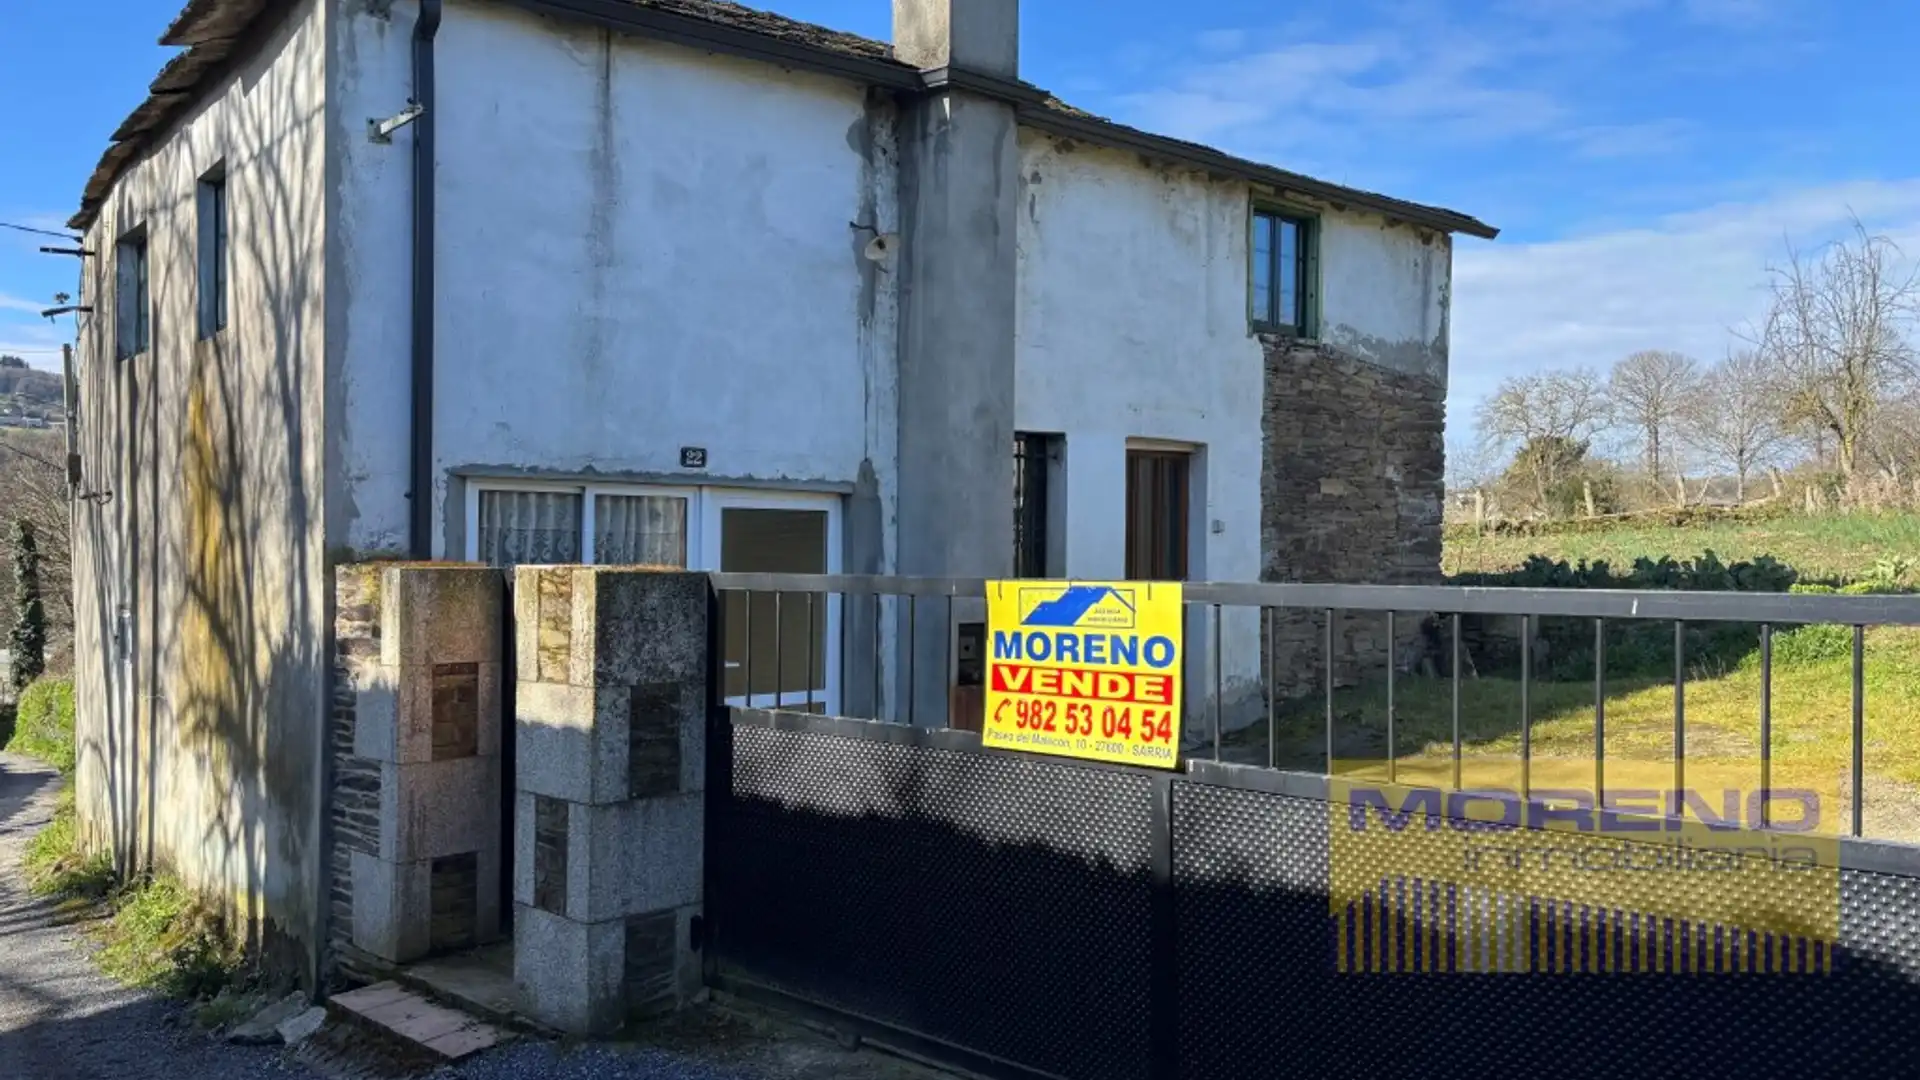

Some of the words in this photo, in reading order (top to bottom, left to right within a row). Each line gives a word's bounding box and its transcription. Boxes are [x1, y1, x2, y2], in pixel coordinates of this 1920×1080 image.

[994, 630, 1175, 669] MORENO
[999, 665, 1166, 703] VENDE
[1016, 699, 1057, 732] 982
[1065, 702, 1093, 736] 53
[1102, 705, 1132, 740] 04
[1140, 709, 1172, 744] 54
[987, 728, 1014, 742] Paseo
[1016, 732, 1030, 743] del
[1076, 738, 1087, 750] 10
[1132, 744, 1173, 760] SARRIA
